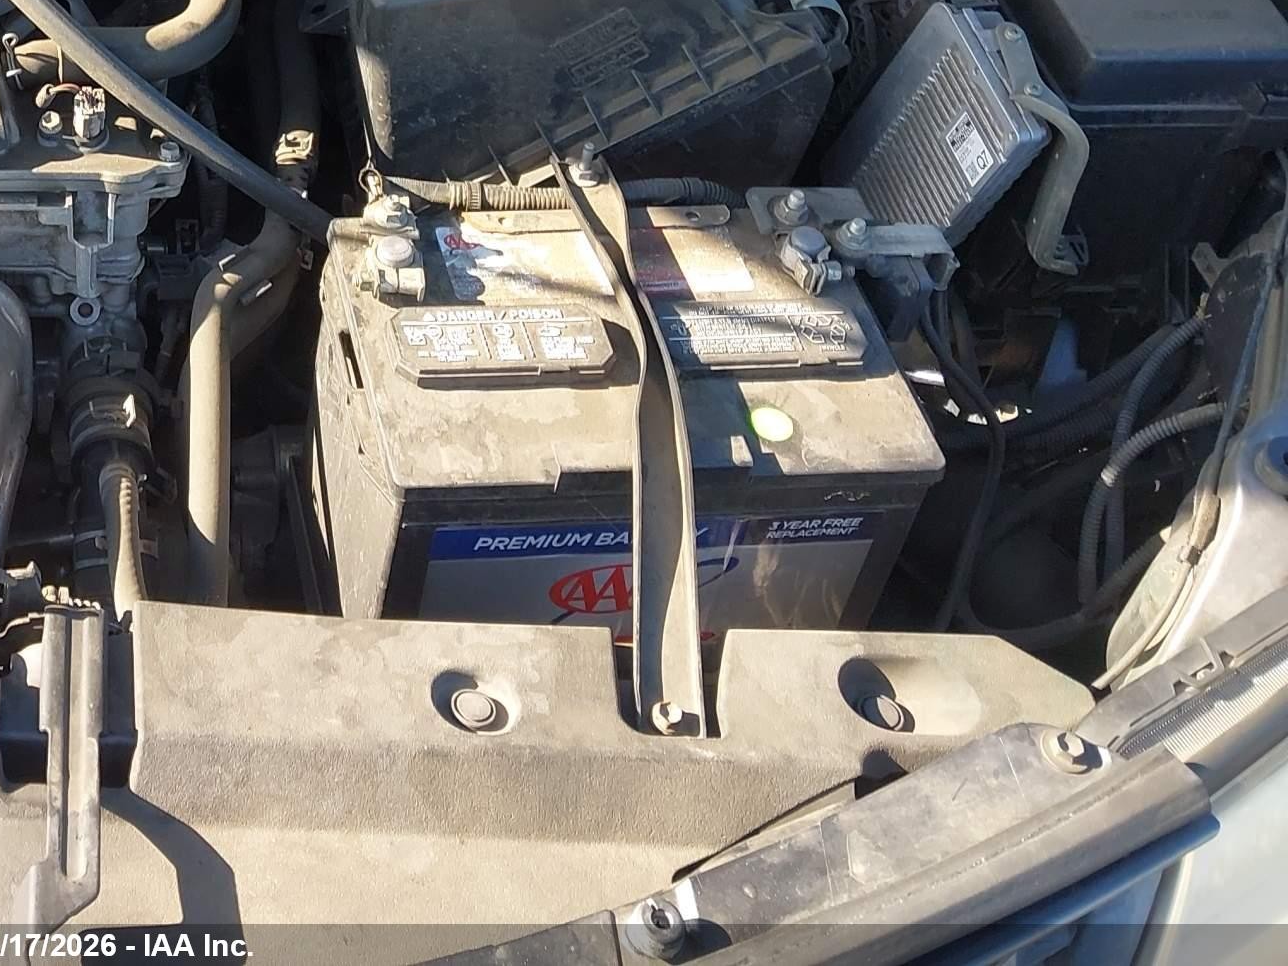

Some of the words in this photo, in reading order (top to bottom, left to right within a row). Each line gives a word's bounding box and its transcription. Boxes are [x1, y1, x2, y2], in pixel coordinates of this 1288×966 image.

[437, 310, 495, 322] DANGER
[511, 308, 564, 320] POISON
[768, 521, 781, 531] 3
[782, 519, 821, 530] YEAR
[822, 516, 864, 528] FREE
[766, 527, 859, 538] REPLACEMENT
[474, 532, 594, 552] PREMIUM
[563, 566, 633, 612] AA
